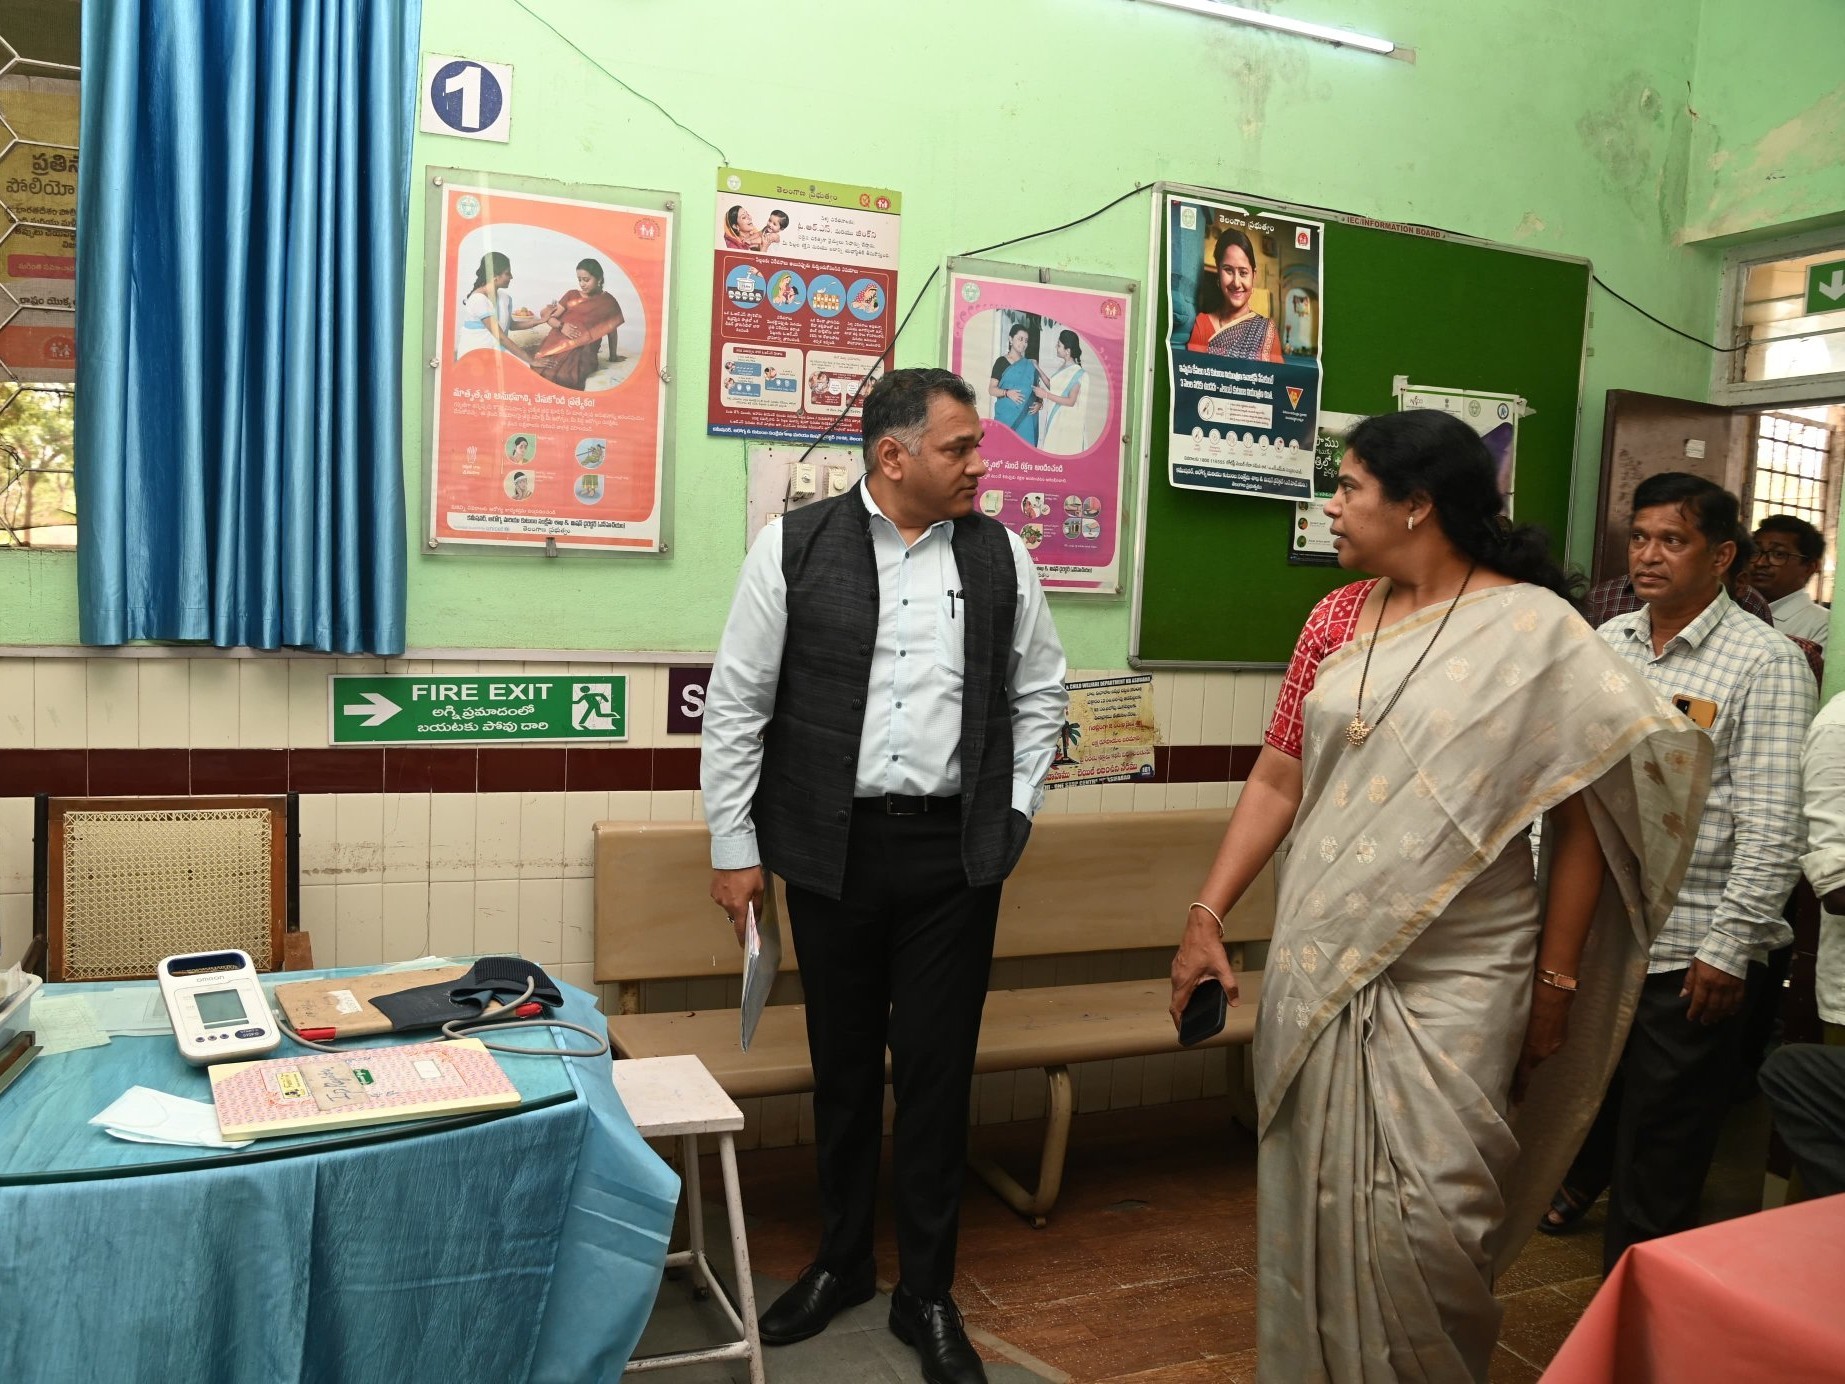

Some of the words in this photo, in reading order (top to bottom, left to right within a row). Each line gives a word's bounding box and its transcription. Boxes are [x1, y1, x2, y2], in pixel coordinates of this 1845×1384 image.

[446, 66, 482, 130] 1
[6, 178, 75, 197] పోలియో
[776, 186, 806, 197] తెలంగాణ
[809, 190, 838, 203] ప్రభుత్వం
[1219, 214, 1245, 226] తెలంగాణ
[1247, 221, 1275, 234] ప్రభుత్వం
[1416, 227, 1441, 238] BOARD
[412, 684, 478, 701] FIRE
[489, 683, 553, 700] EXIT
[432, 705, 461, 720] అగ్ని
[462, 704, 535, 719] ప్రమాదంలో
[417, 721, 479, 733] బయటకు
[483, 720, 518, 734] పోవు
[521, 720, 549, 732] దారి
